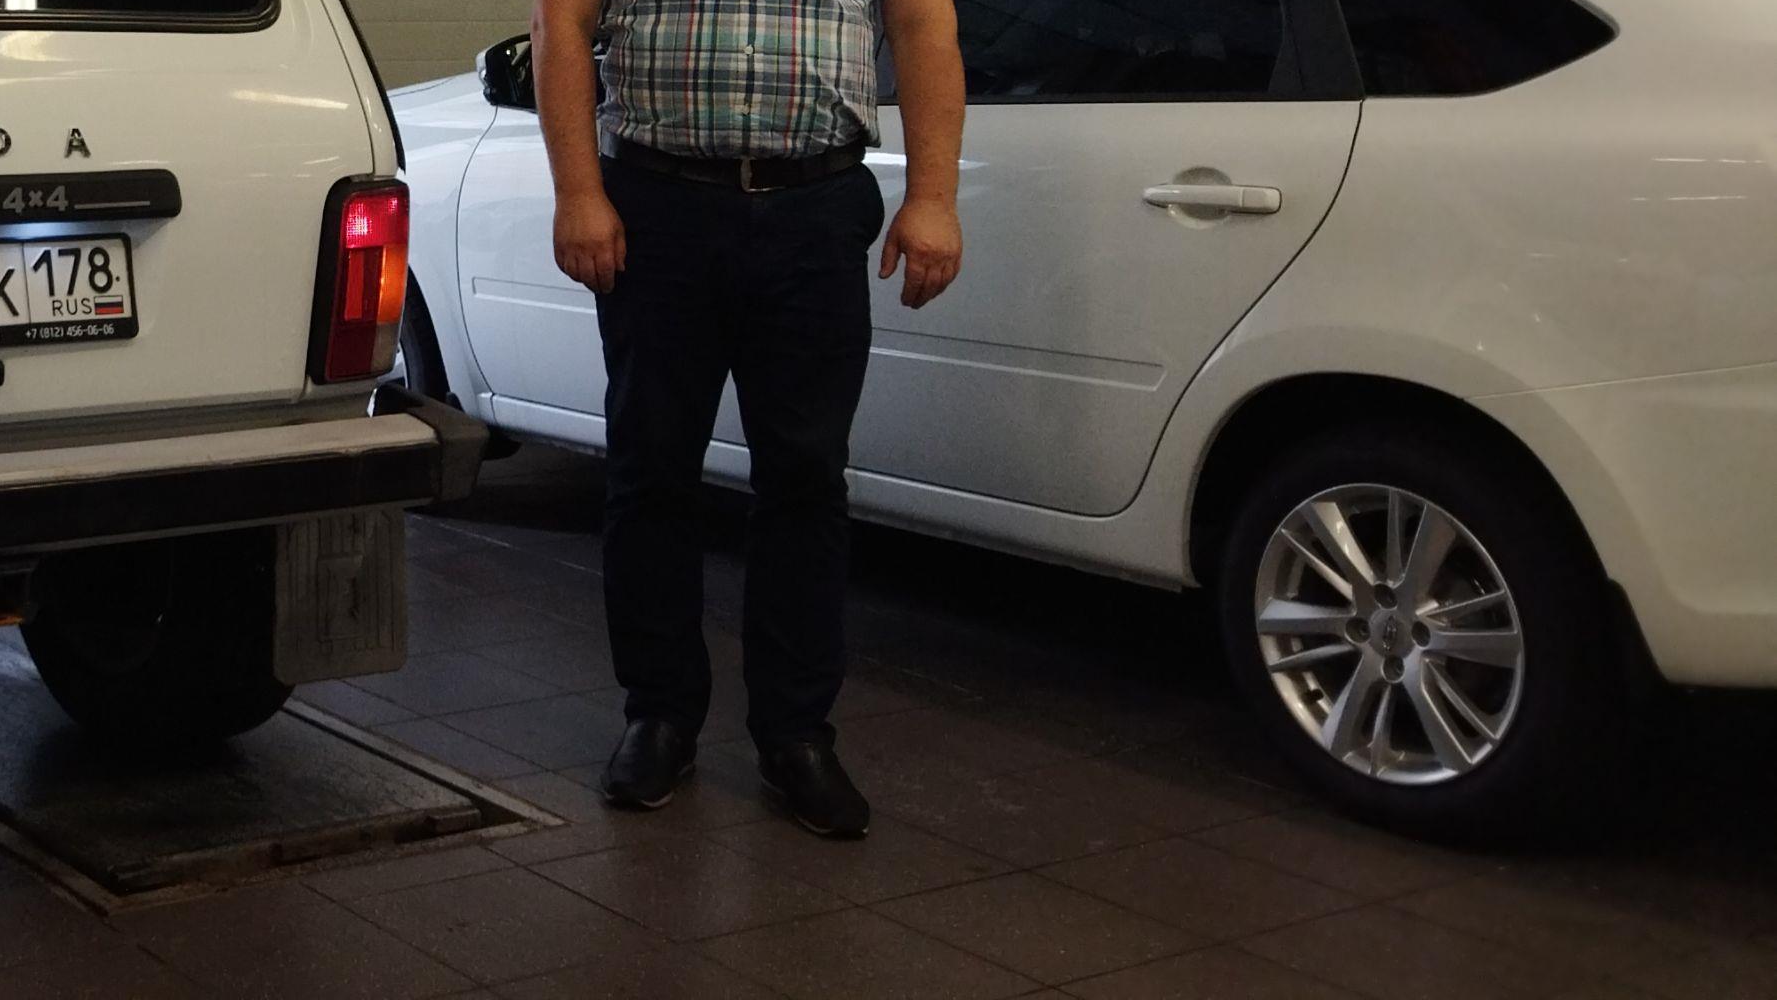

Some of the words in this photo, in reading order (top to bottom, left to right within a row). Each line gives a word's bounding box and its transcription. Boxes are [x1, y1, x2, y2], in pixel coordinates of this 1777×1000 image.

[31, 247, 113, 297] 178
[52, 299, 92, 316] RUS
[25, 328, 38, 339] +7
[39, 326, 64, 339] (812)
[65, 323, 115, 337] 456-06-06
